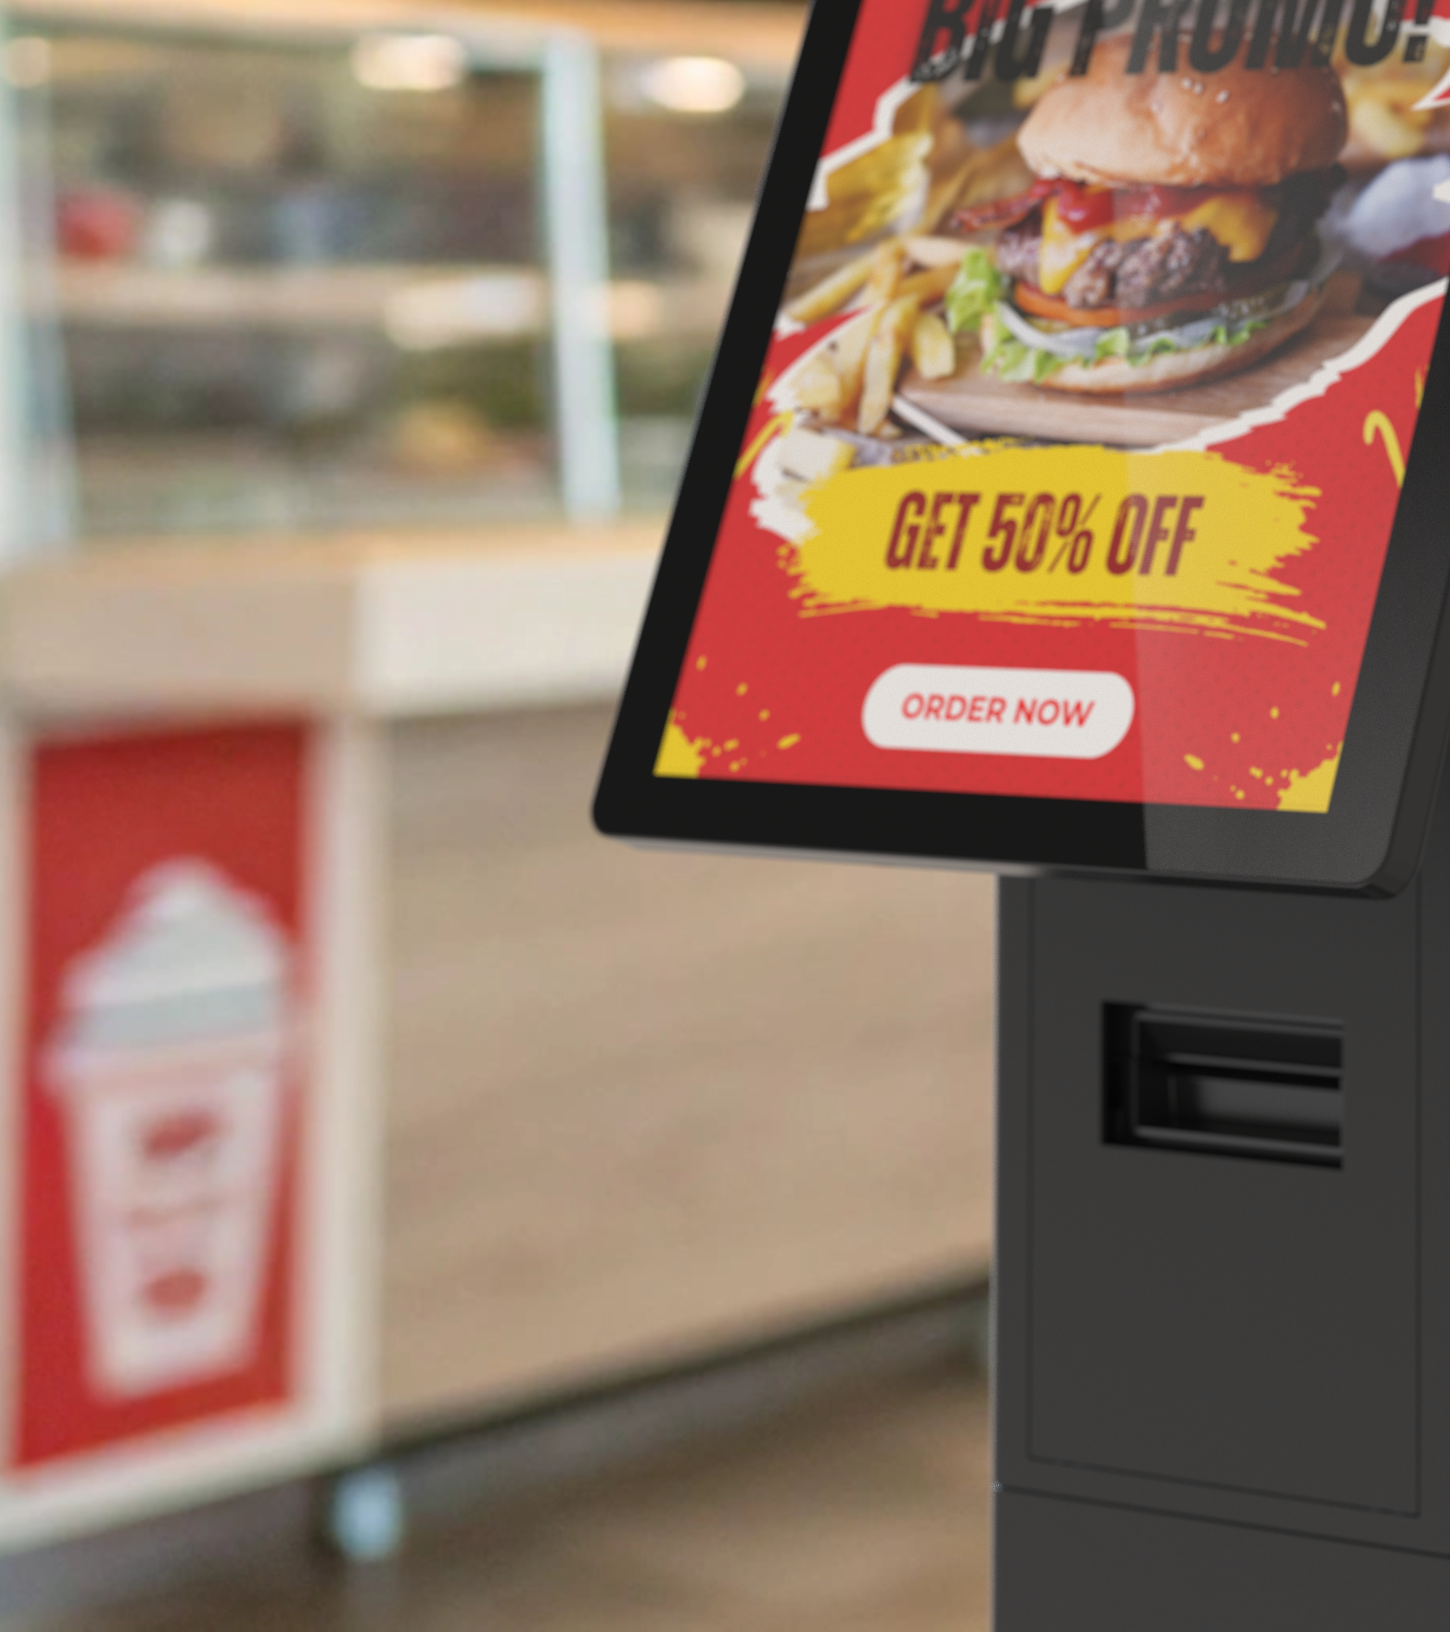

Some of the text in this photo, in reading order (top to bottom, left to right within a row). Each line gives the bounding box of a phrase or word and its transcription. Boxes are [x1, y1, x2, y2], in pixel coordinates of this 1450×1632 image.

[885, 490, 1205, 577] GET 50% OFF
[901, 693, 1095, 727] ORDER NOW
